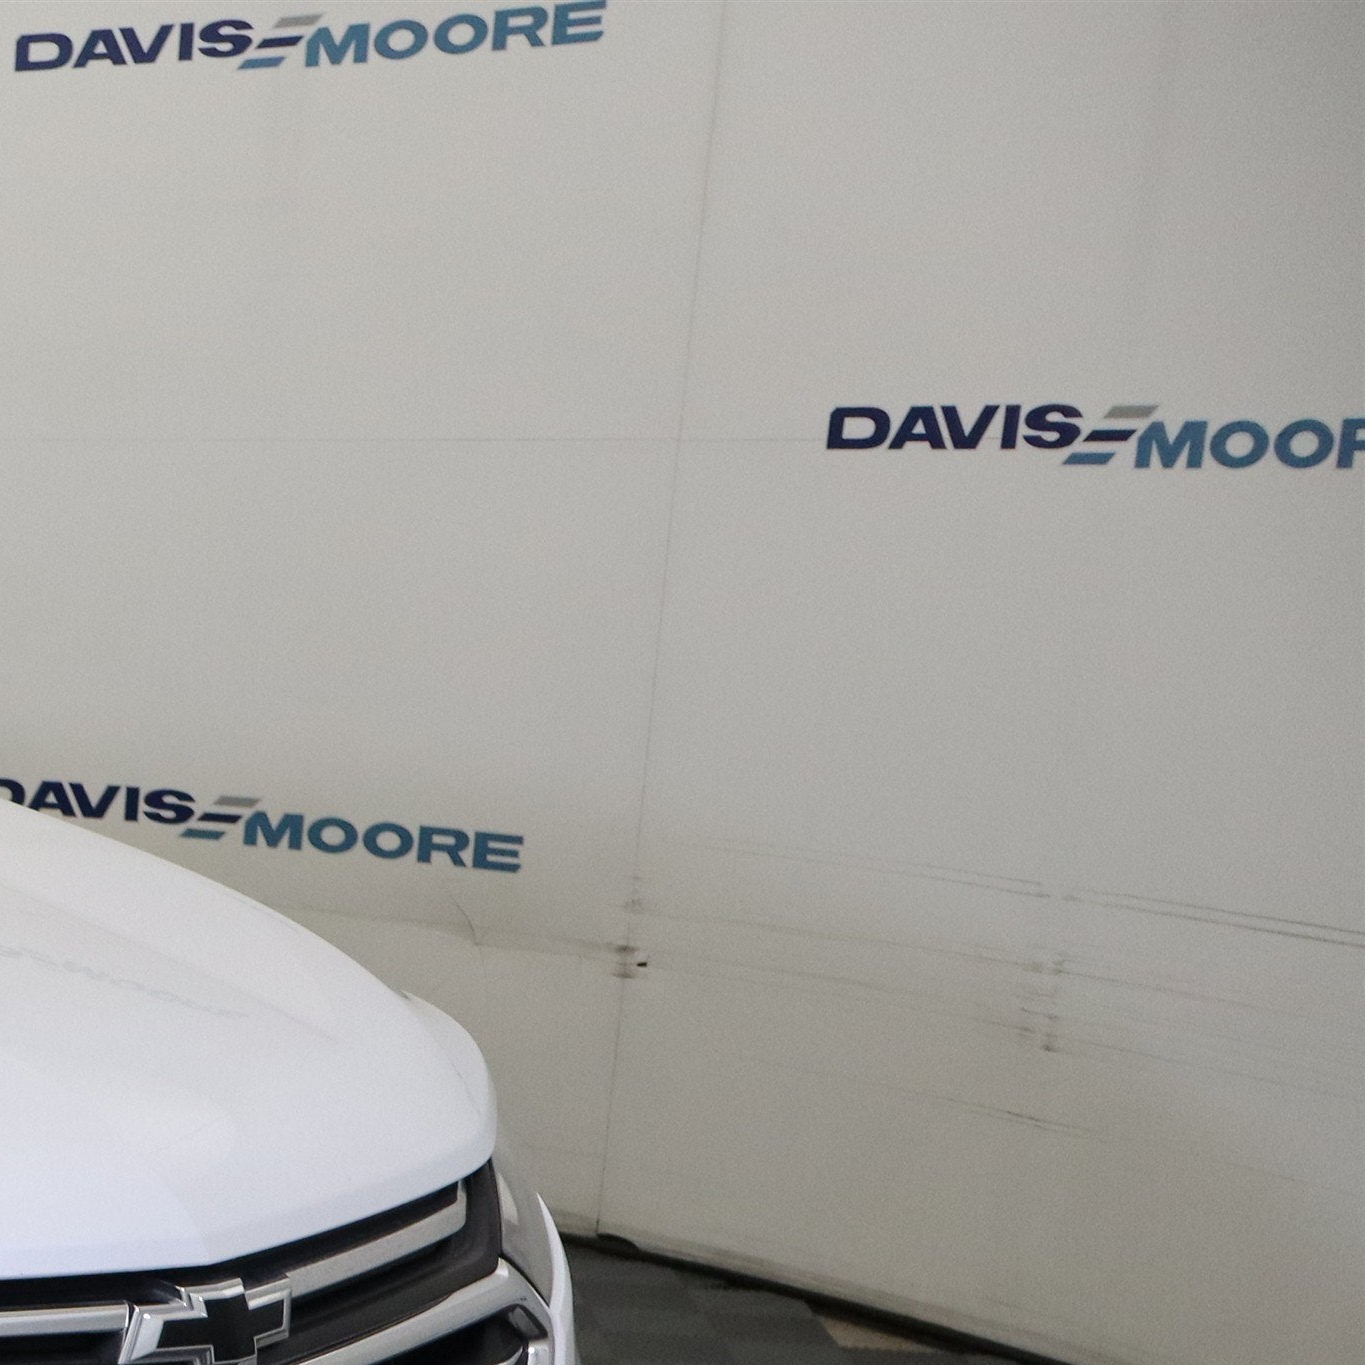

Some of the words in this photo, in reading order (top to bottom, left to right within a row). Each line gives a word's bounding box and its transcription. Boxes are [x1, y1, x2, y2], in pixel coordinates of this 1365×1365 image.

[14, 19, 254, 73] DAVIS
[304, 0, 608, 68] MOORE
[826, 403, 1082, 450] DAVIS
[242, 810, 525, 874] MOORE
